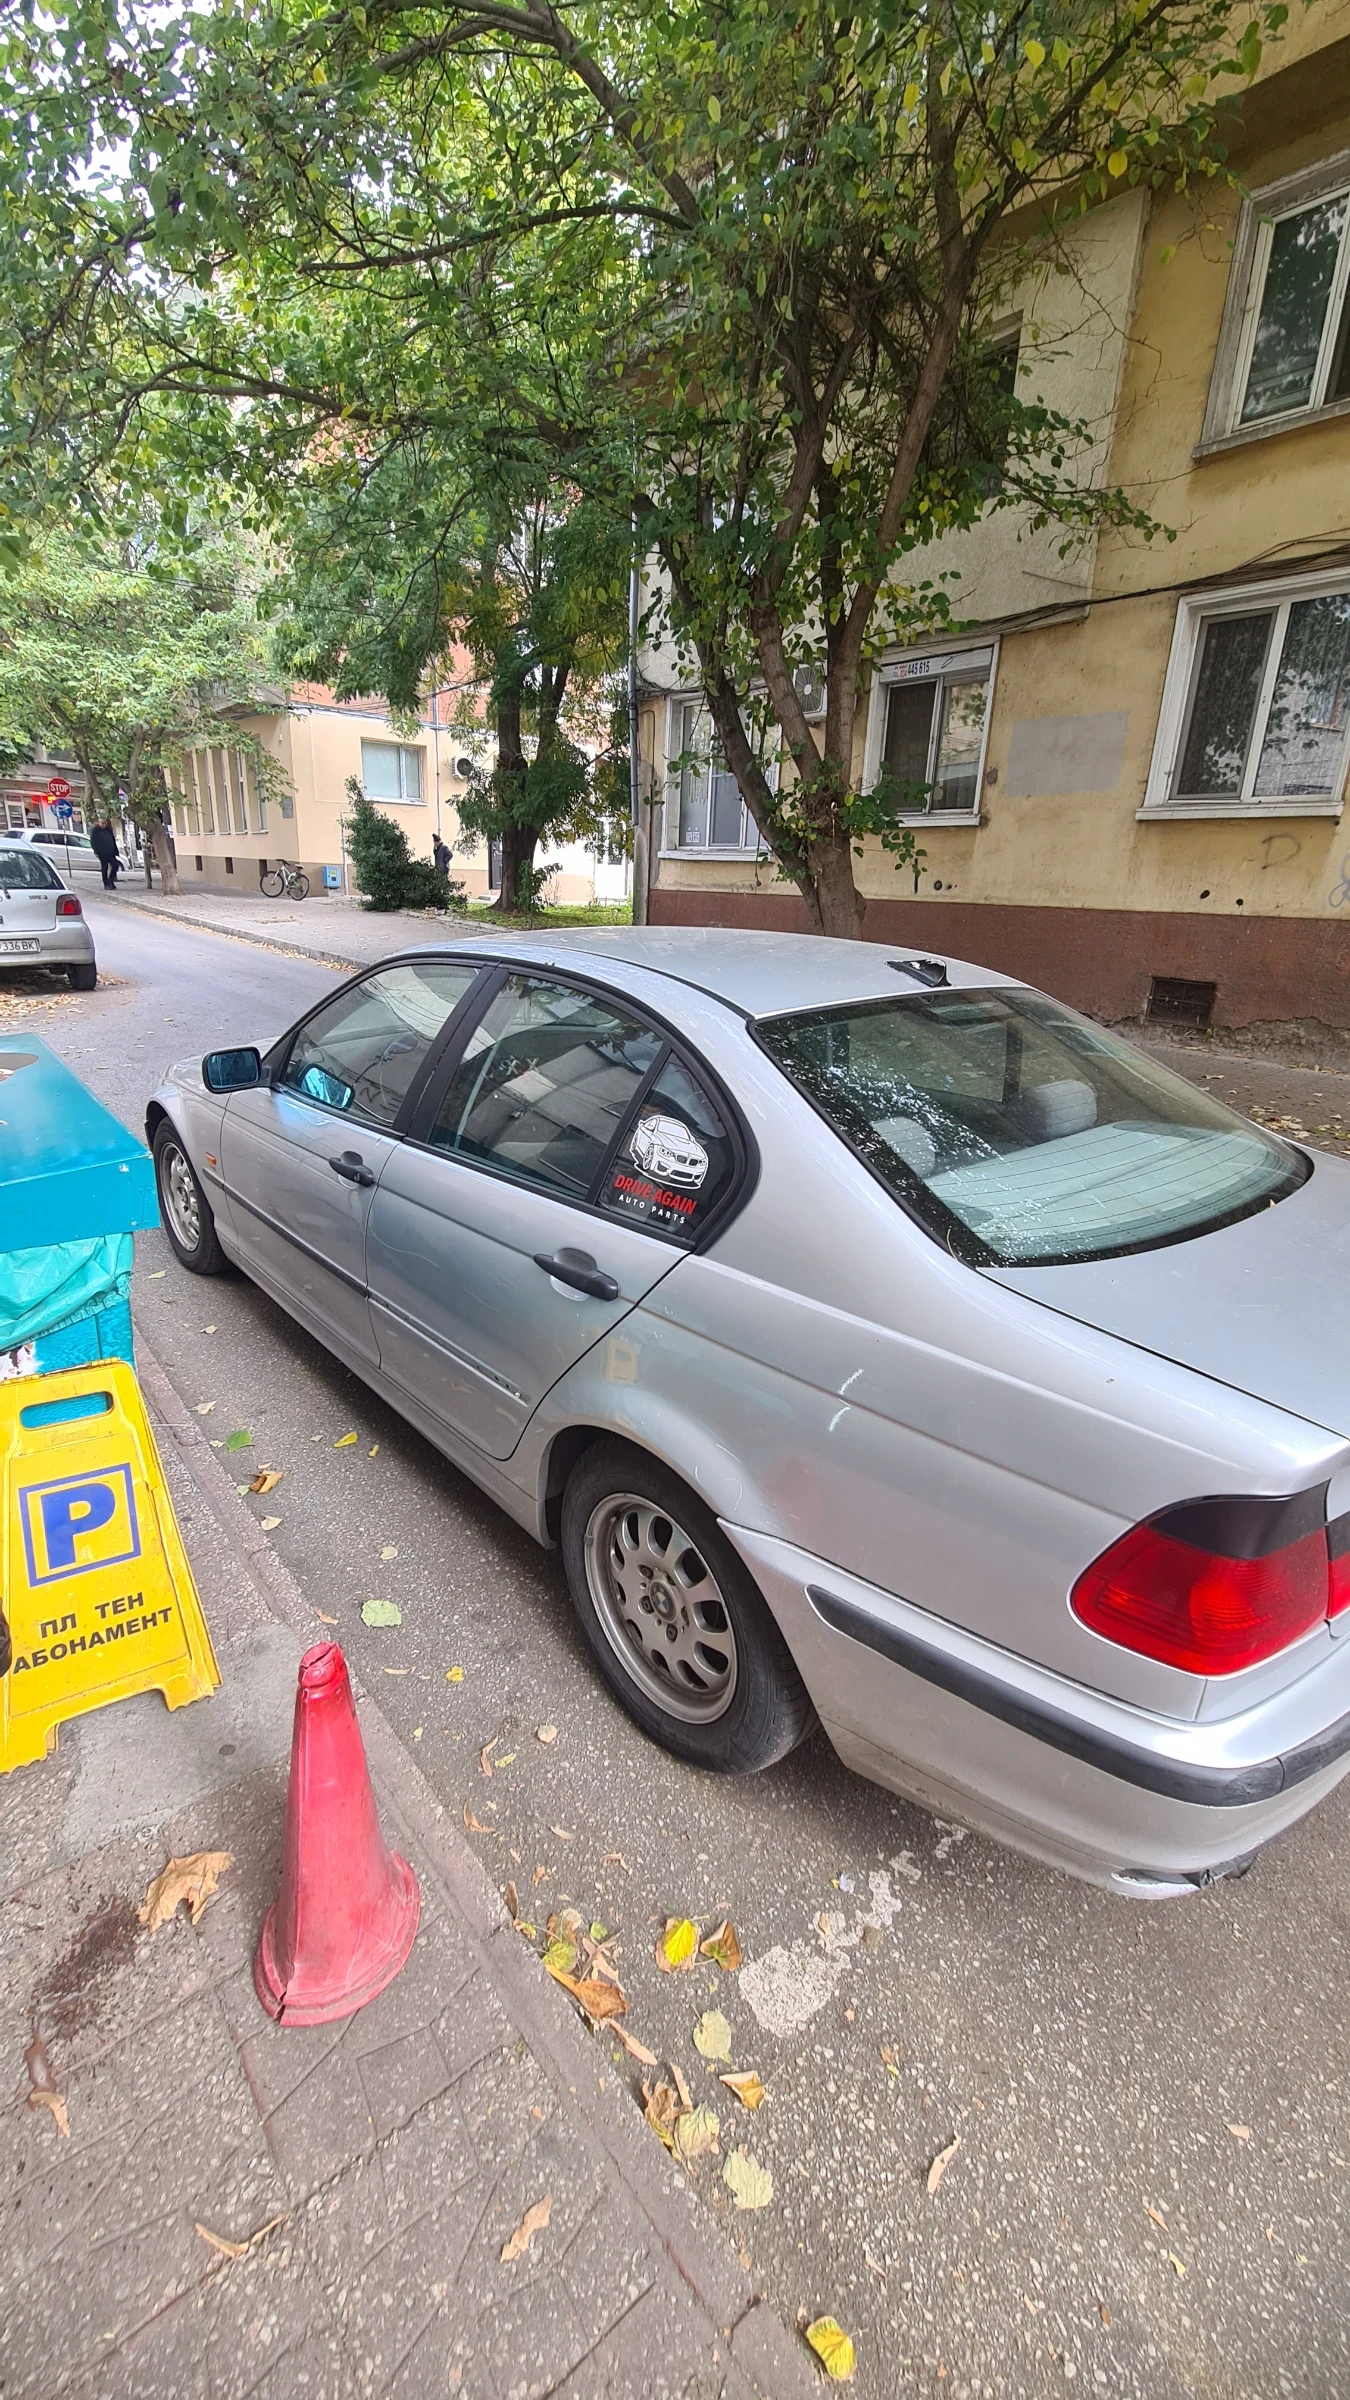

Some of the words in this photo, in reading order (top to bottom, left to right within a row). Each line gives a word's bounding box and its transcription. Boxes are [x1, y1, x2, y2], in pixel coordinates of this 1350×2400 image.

[908, 663, 918, 675] 445
[919, 661, 929, 673] 615
[50, 783, 69, 792] STOP
[0, 942, 20, 951] 336
[22, 941, 34, 950] BK
[614, 1175, 653, 1199] DRIVE
[654, 1188, 697, 1215] AGAIN
[618, 1194, 645, 1208] AUTO
[651, 1206, 685, 1224] PARTS
[41, 1483, 115, 1570] P
[40, 1613, 77, 1639] ПЛ
[94, 1592, 144, 1619] ТЕН
[13, 1607, 172, 1674] АБОНАМЕНТ
